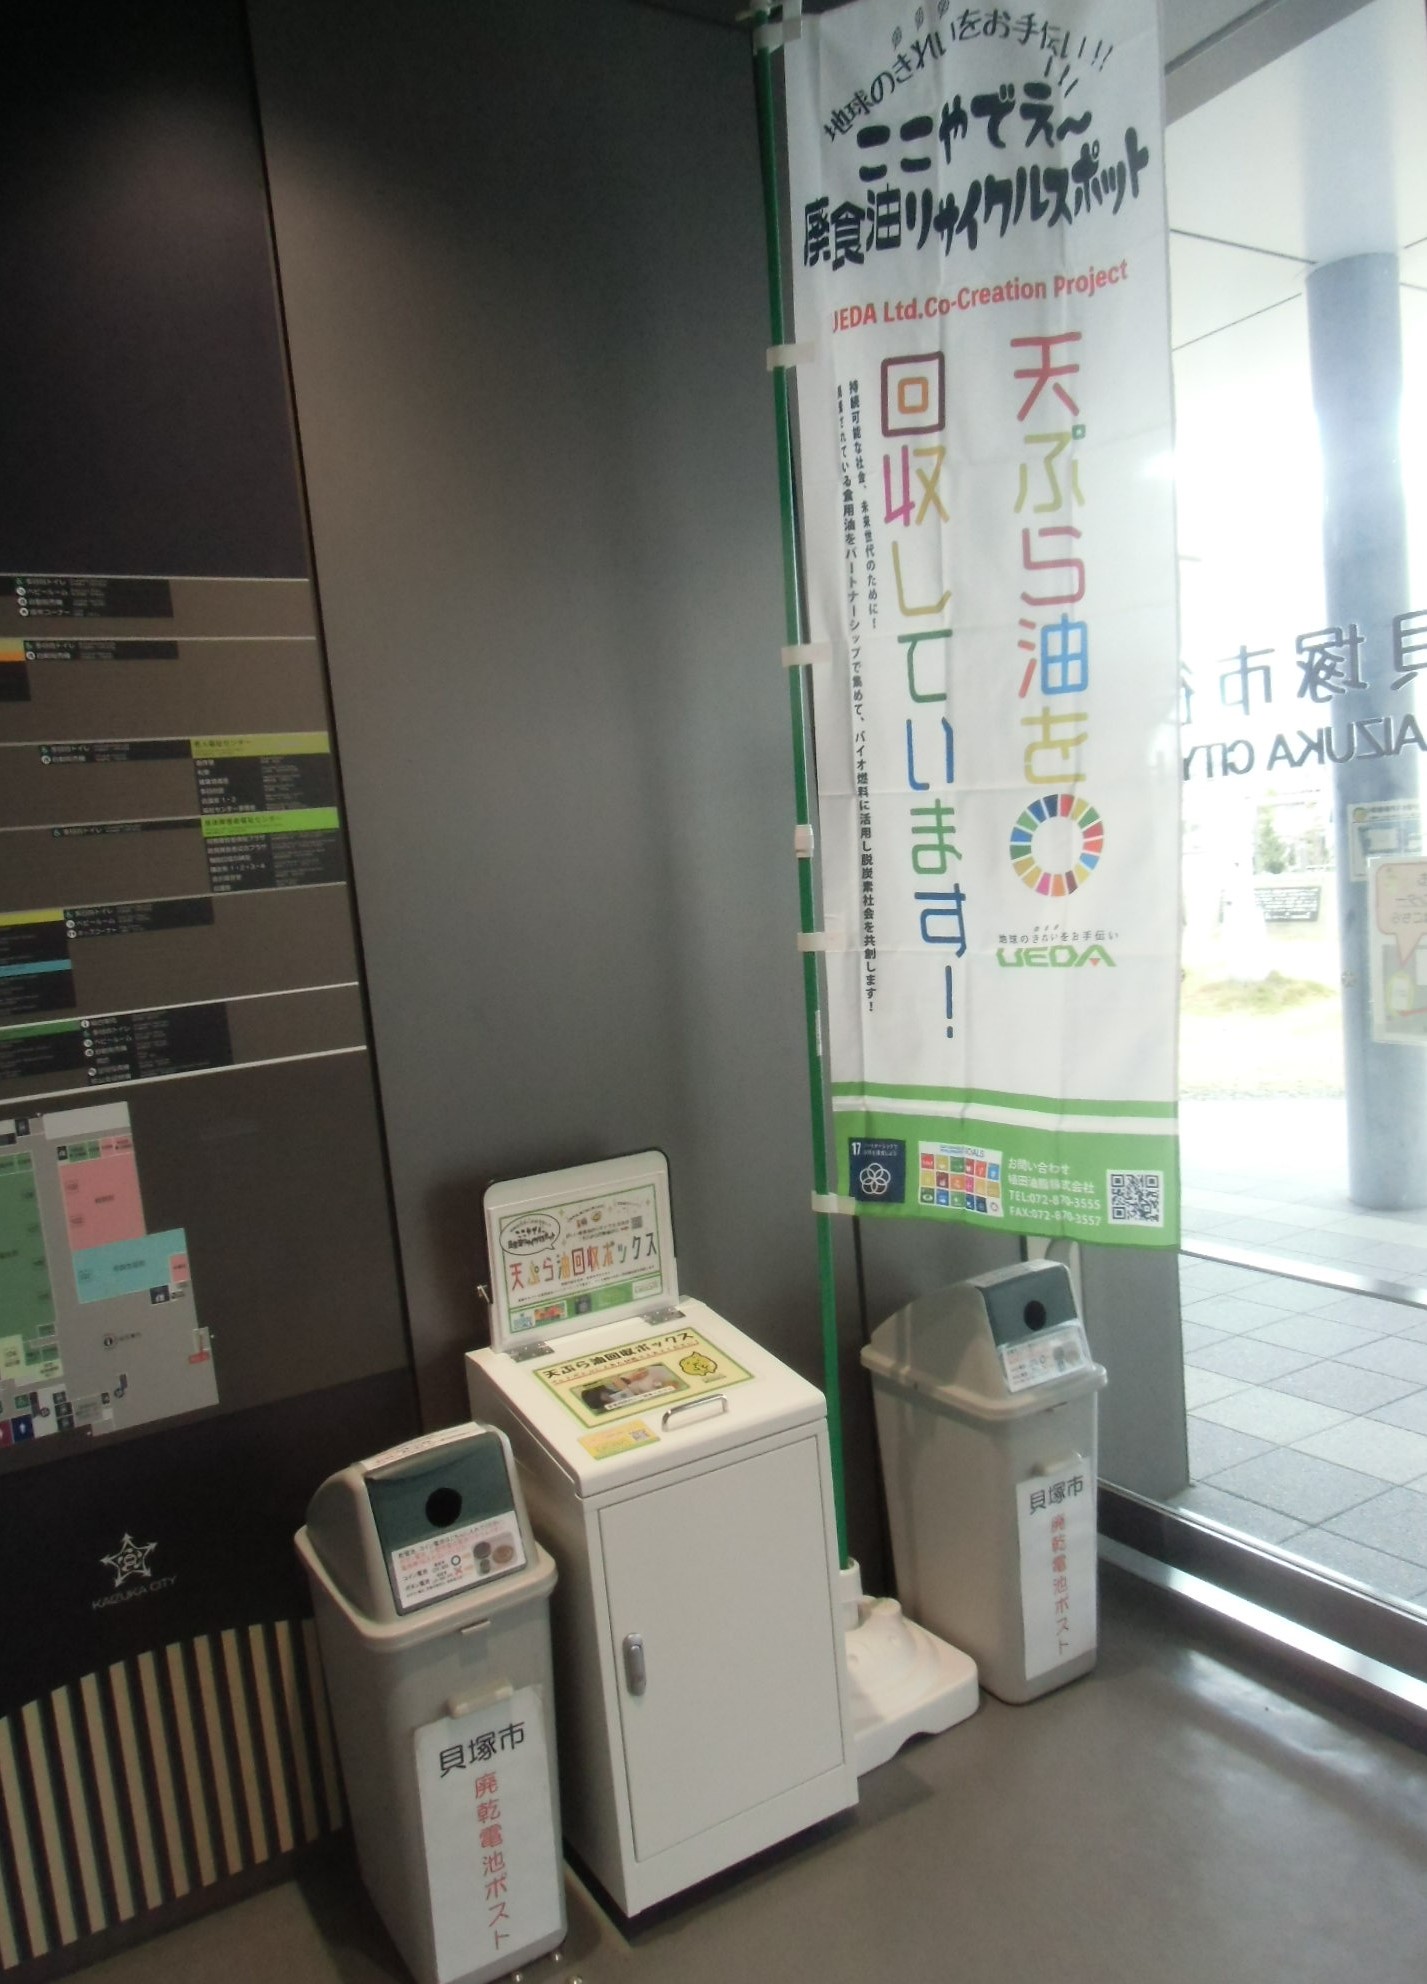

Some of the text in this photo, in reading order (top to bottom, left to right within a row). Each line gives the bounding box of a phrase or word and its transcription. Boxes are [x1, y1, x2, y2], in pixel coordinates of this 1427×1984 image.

[803, 127, 1149, 271] 廃食油リサイクルスポット
[1054, 259, 1129, 297] Project
[996, 944, 1117, 968] UEDA
[851, 1141, 861, 1156] 17
[1008, 1157, 1070, 1175] お問い合わせ
[1029, 1475, 1084, 1515] 貝塚市
[439, 1721, 526, 1778] 貝塚市
